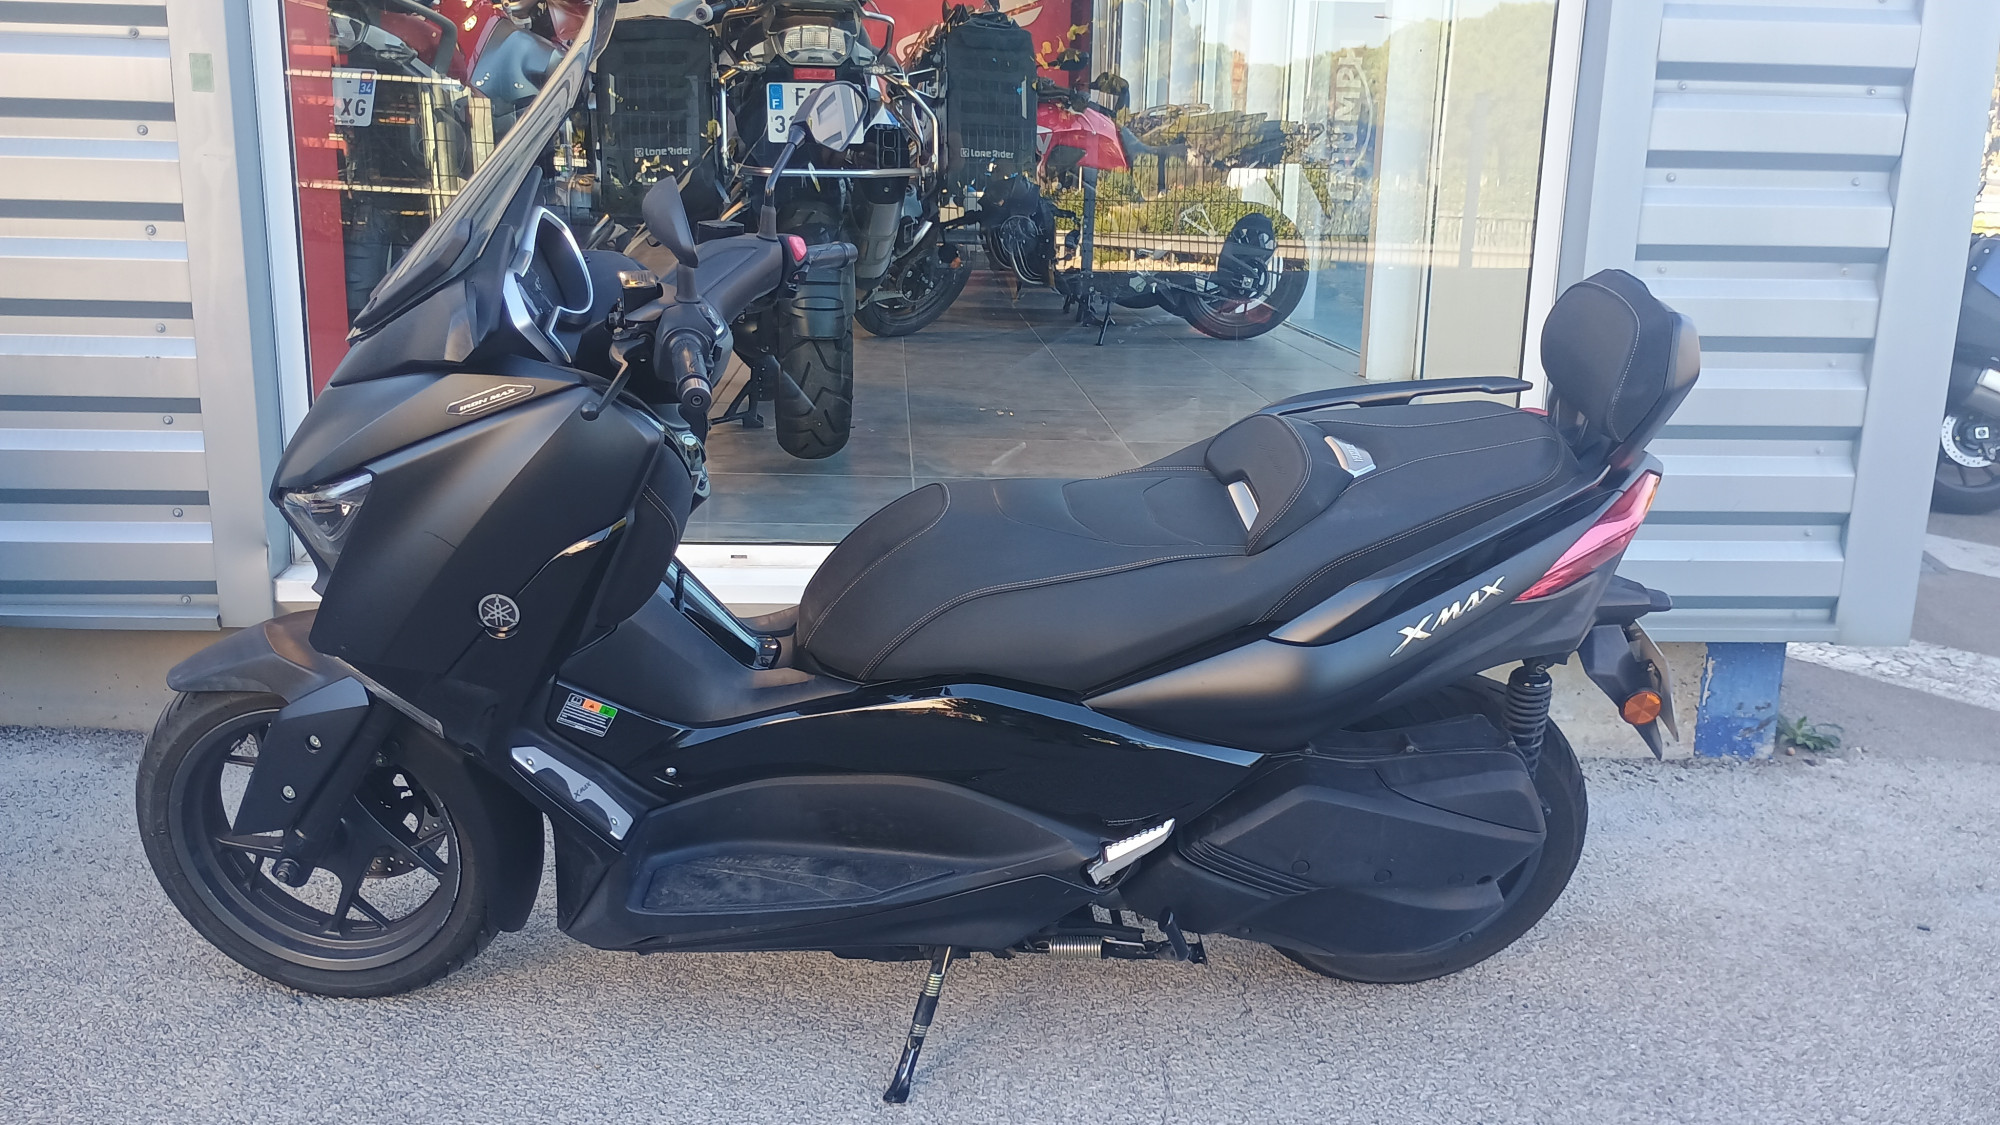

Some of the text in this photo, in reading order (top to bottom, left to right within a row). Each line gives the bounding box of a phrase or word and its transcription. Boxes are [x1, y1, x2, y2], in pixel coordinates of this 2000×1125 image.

[360, 82, 372, 93] 34
[341, 98, 367, 117] XG
[772, 98, 780, 109] F
[459, 387, 516, 411] IRON MAX
